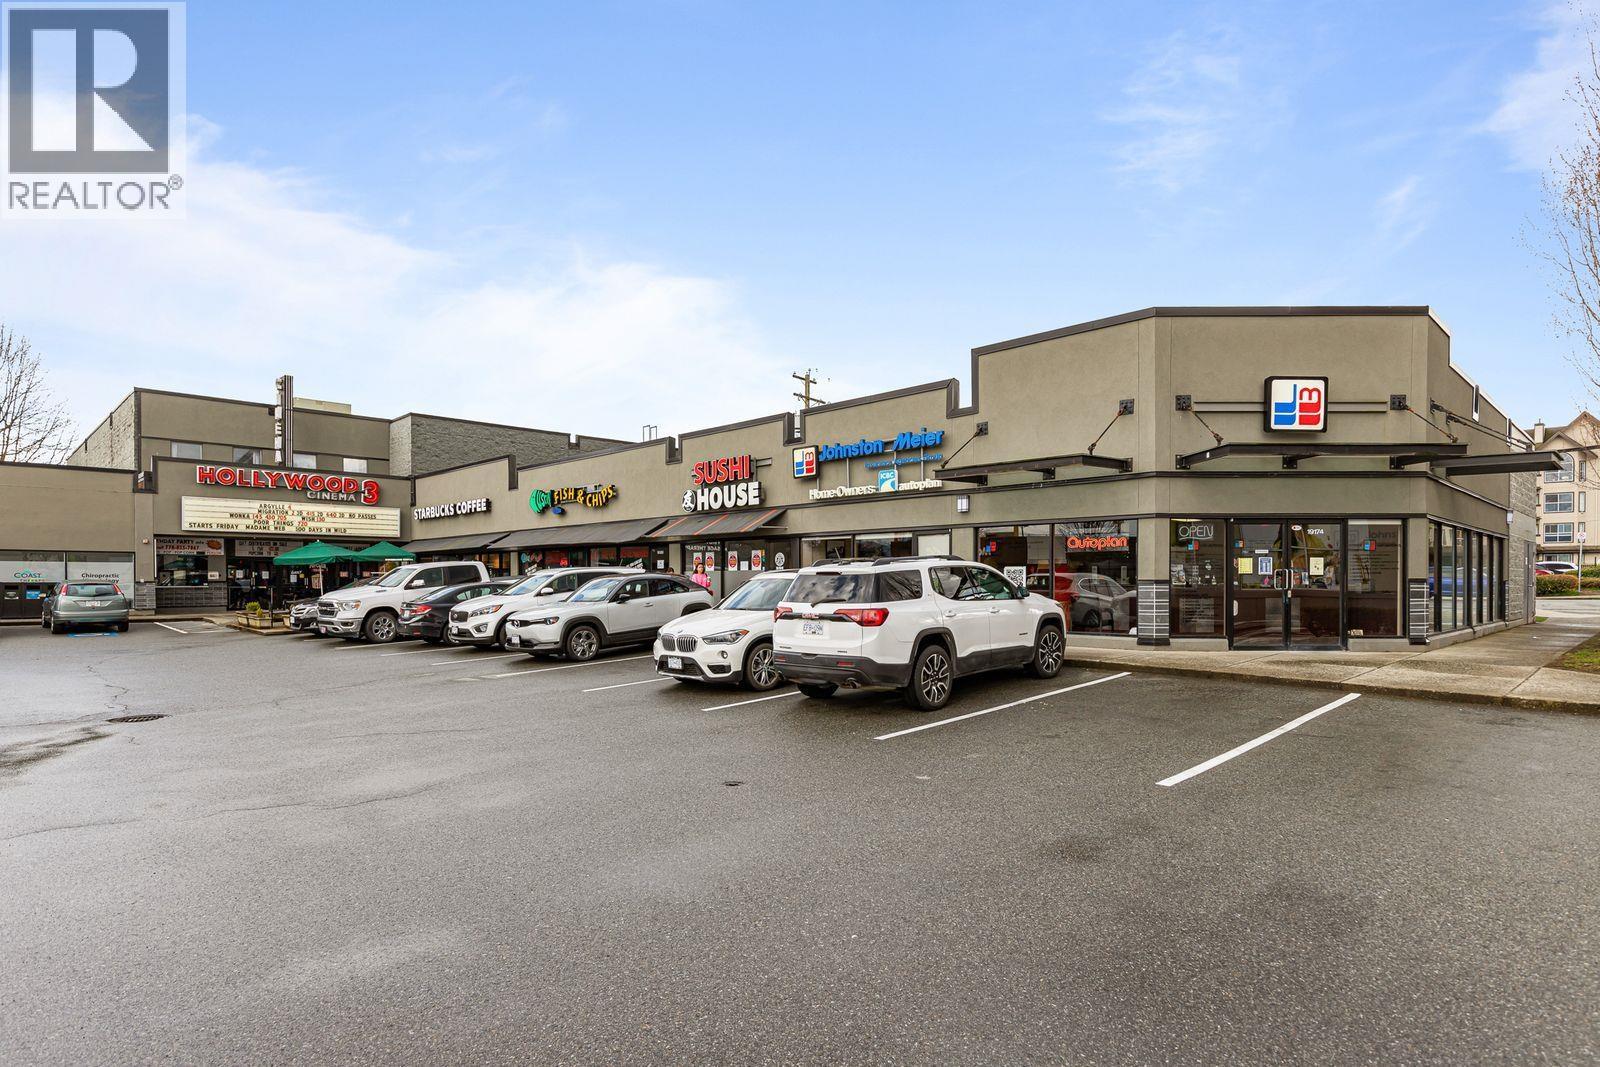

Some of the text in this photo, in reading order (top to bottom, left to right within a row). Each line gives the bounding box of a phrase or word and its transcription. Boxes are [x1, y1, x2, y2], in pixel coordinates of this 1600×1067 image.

[819, 427, 945, 462] Johnston Meier
[693, 454, 751, 485] SUSHI
[196, 465, 380, 505] HOLLYWOOD 3
[553, 484, 614, 507] FISH & CHIPS
[898, 478, 943, 491] autoplan
[306, 491, 356, 502] CINEMA
[696, 481, 760, 511] HOUSE
[413, 498, 487, 520] STARBUCKS COFFEE
[1178, 524, 1214, 539] OPEN
[81, 572, 120, 581] Chiropractic
